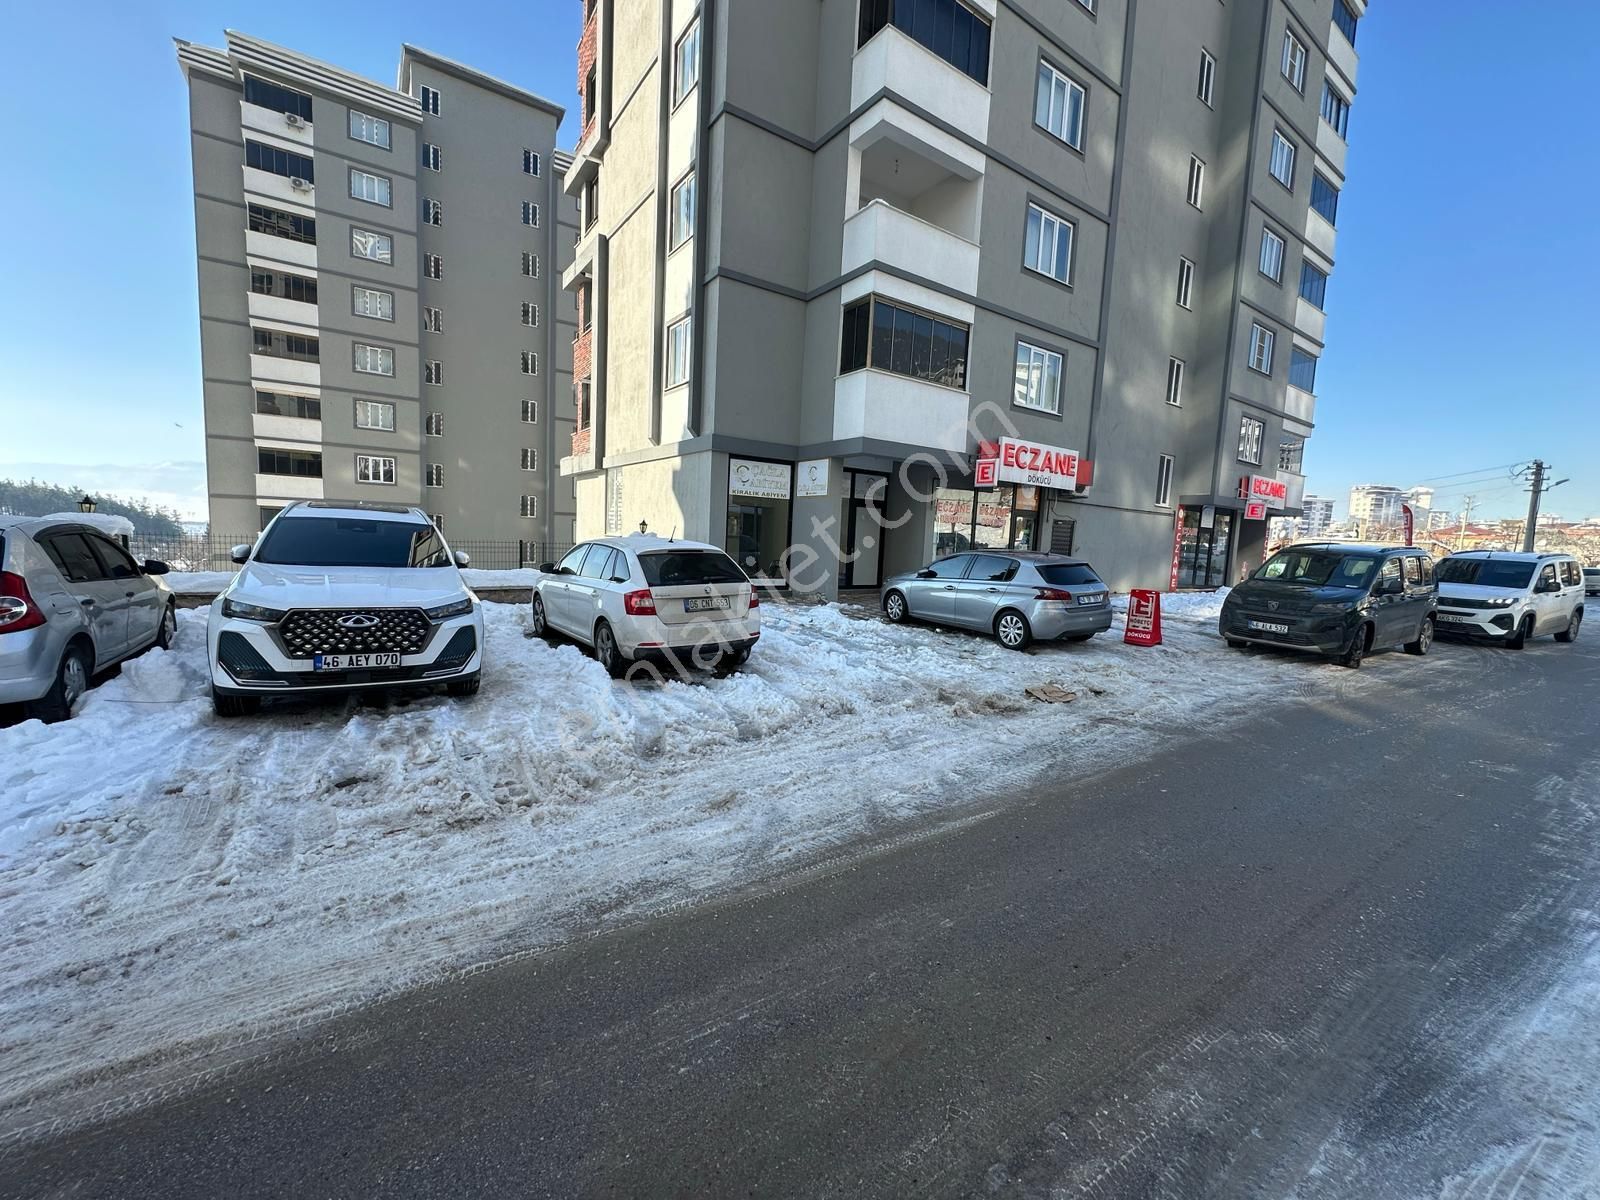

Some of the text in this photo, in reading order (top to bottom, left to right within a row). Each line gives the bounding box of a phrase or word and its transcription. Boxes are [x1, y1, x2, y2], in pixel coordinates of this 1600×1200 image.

[1003, 443, 1077, 477] ECZANE
[1027, 474, 1052, 486] DÖKÜCÜ
[1253, 478, 1286, 499] ECZANE
[1170, 522, 1183, 587] ECZANE
[323, 653, 398, 667] 46 AEY 070
